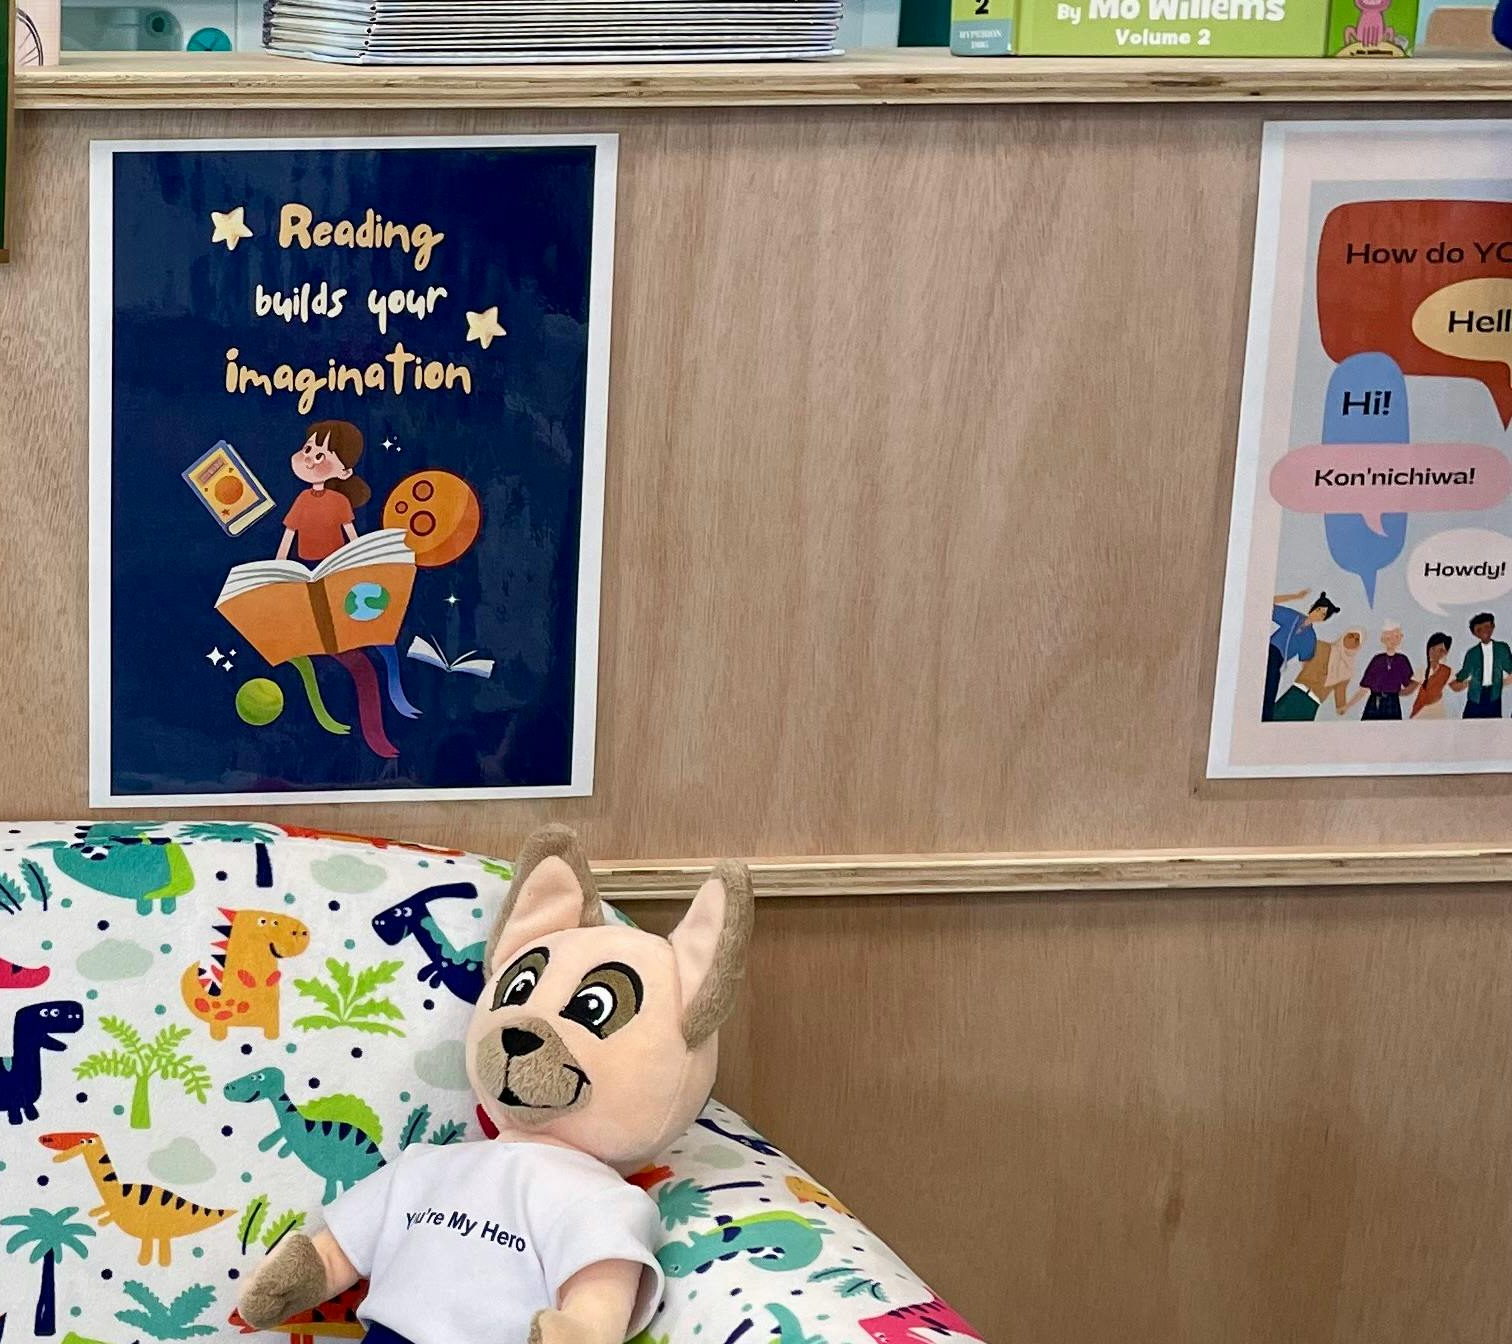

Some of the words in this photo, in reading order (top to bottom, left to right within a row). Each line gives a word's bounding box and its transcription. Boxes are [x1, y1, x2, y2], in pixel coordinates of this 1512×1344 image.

[1056, 2, 1082, 25] By
[1114, 28, 1191, 46] Volume
[1197, 28, 1211, 46] 2
[278, 202, 445, 272] Reading
[1346, 242, 1418, 264] How
[1426, 241, 1465, 264] do
[255, 281, 348, 324] builds
[367, 285, 449, 335] your
[225, 341, 472, 416] imagination
[1342, 390, 1393, 416] Hi!
[1314, 467, 1476, 487] Kon'nichiwa!
[1424, 561, 1507, 580] Howdy!
[447, 1211, 478, 1237] My
[480, 1220, 527, 1252] Hero
